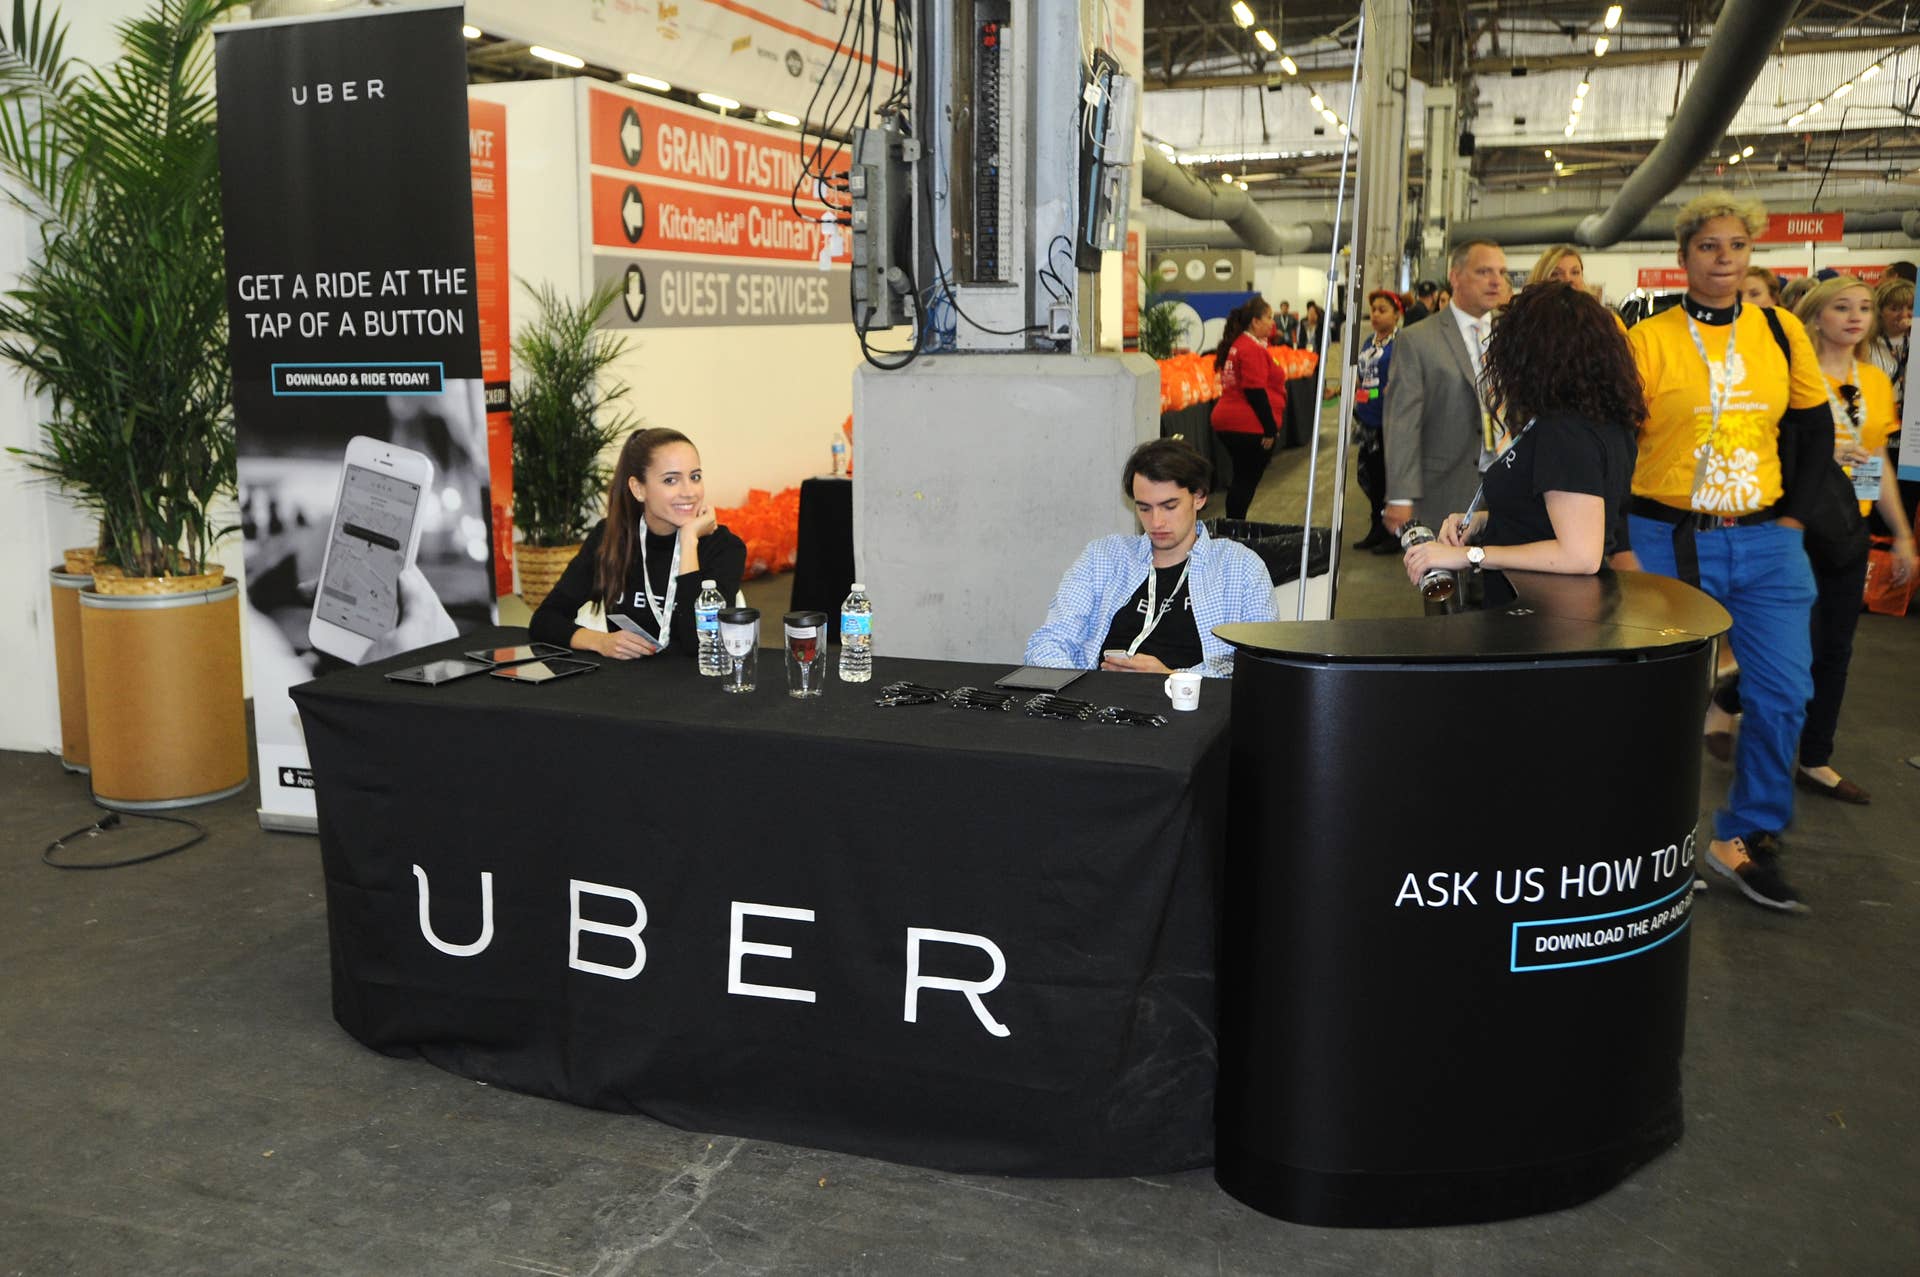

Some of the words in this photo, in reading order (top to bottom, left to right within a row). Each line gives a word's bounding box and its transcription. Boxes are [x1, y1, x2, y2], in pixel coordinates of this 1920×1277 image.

[292, 79, 385, 105] UBER
[657, 123, 730, 181] GRAND
[748, 206, 821, 260] Culinary
[1787, 219, 1824, 235] BUICK
[238, 274, 284, 300] GET
[292, 273, 309, 299] A
[316, 271, 373, 298] RIDE
[380, 270, 411, 296] AT
[418, 267, 468, 295] THE
[660, 269, 730, 316] GUEST
[736, 273, 829, 315] SERVICES
[246, 312, 292, 338] TAP
[299, 311, 330, 338] OF
[338, 311, 357, 337] A
[364, 308, 465, 336] BUTTON
[285, 373, 348, 387] DOWNLOAD
[350, 373, 359, 386] &
[360, 373, 387, 386] RIDE
[388, 372, 430, 386] TODAY!
[1394, 871, 1480, 907] ASK
[1495, 867, 1546, 904] US
[1560, 855, 1643, 900] HOW
[1651, 844, 1678, 882] TO
[412, 864, 1012, 1038] UBER
[1535, 925, 1625, 953] DOWNLOAD
[1627, 918, 1650, 940] THE
[1650, 910, 1670, 932] APP
